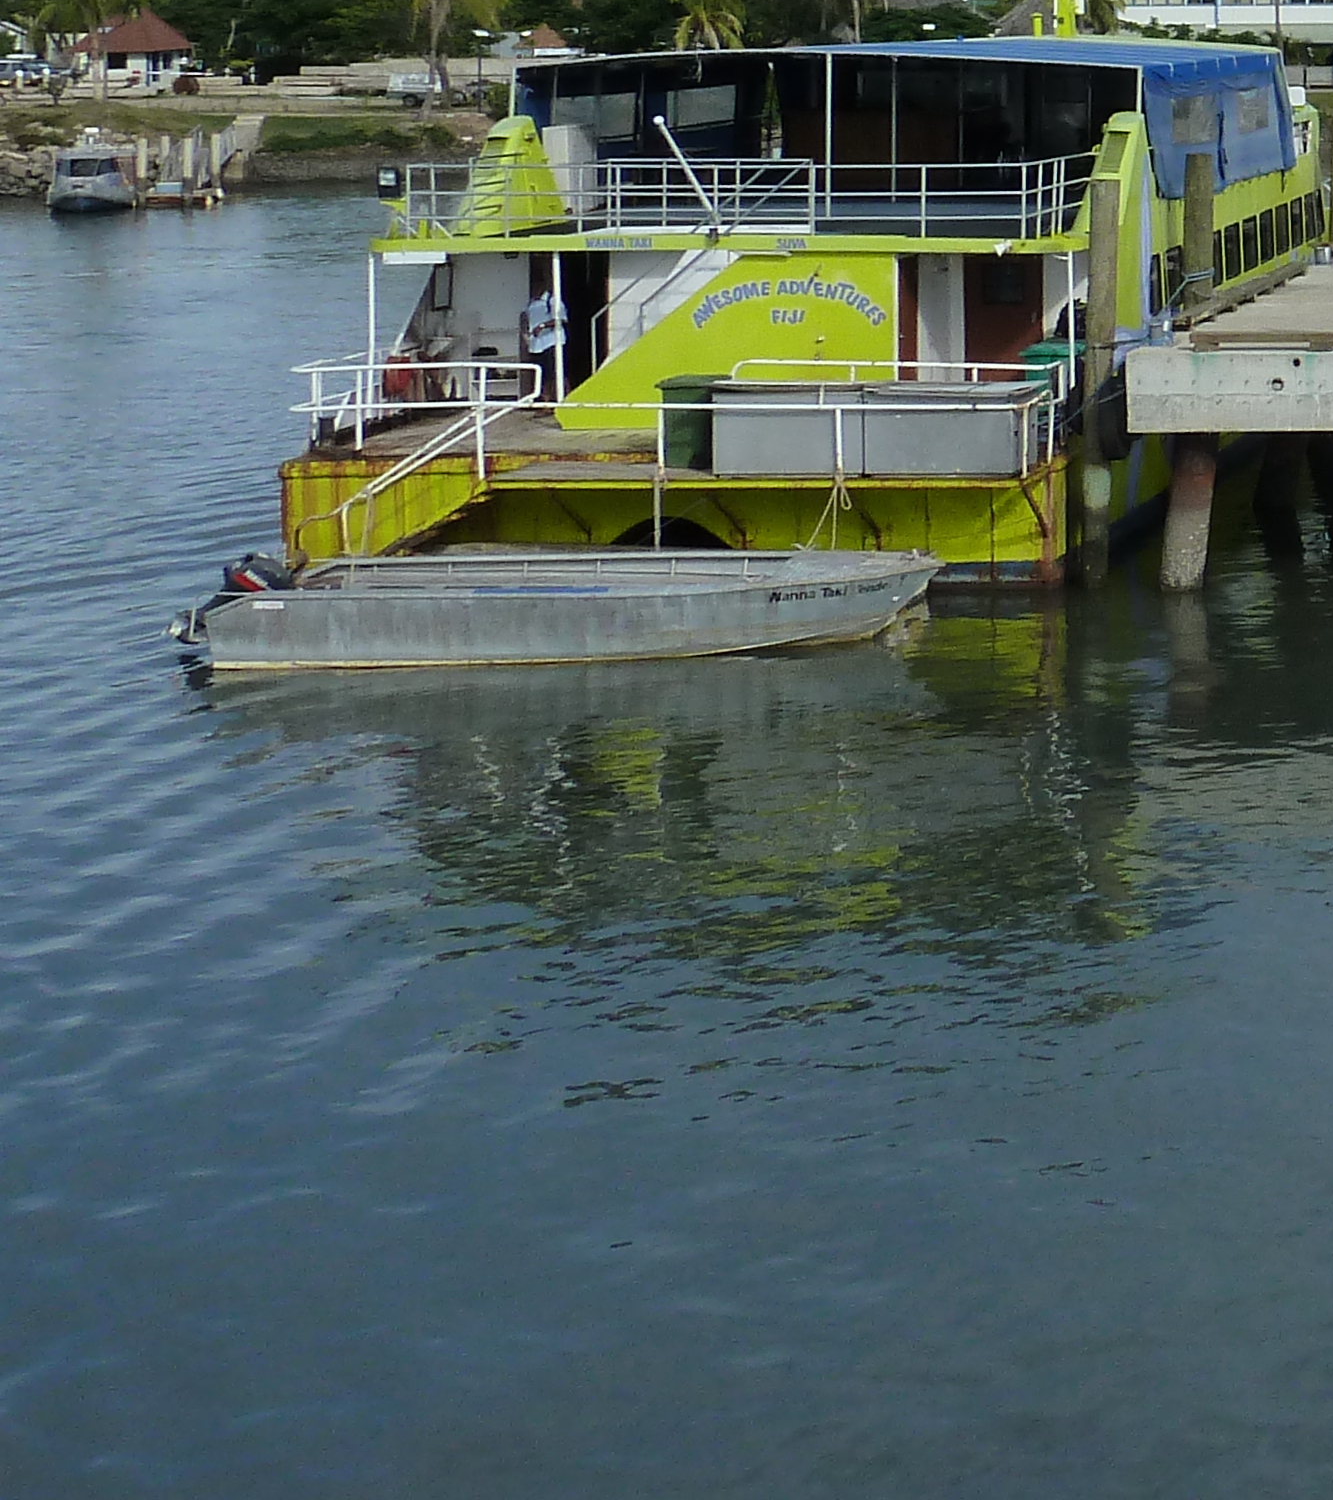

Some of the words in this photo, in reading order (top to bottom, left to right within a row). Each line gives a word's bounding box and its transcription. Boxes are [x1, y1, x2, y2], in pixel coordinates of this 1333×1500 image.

[585, 238, 625, 249] WANNA
[628, 238, 653, 249] TAKI
[776, 238, 807, 250] SUVA
[692, 280, 771, 329] AWESOME
[776, 276, 887, 327] ADVENTURES
[771, 309, 806, 325] FIJI
